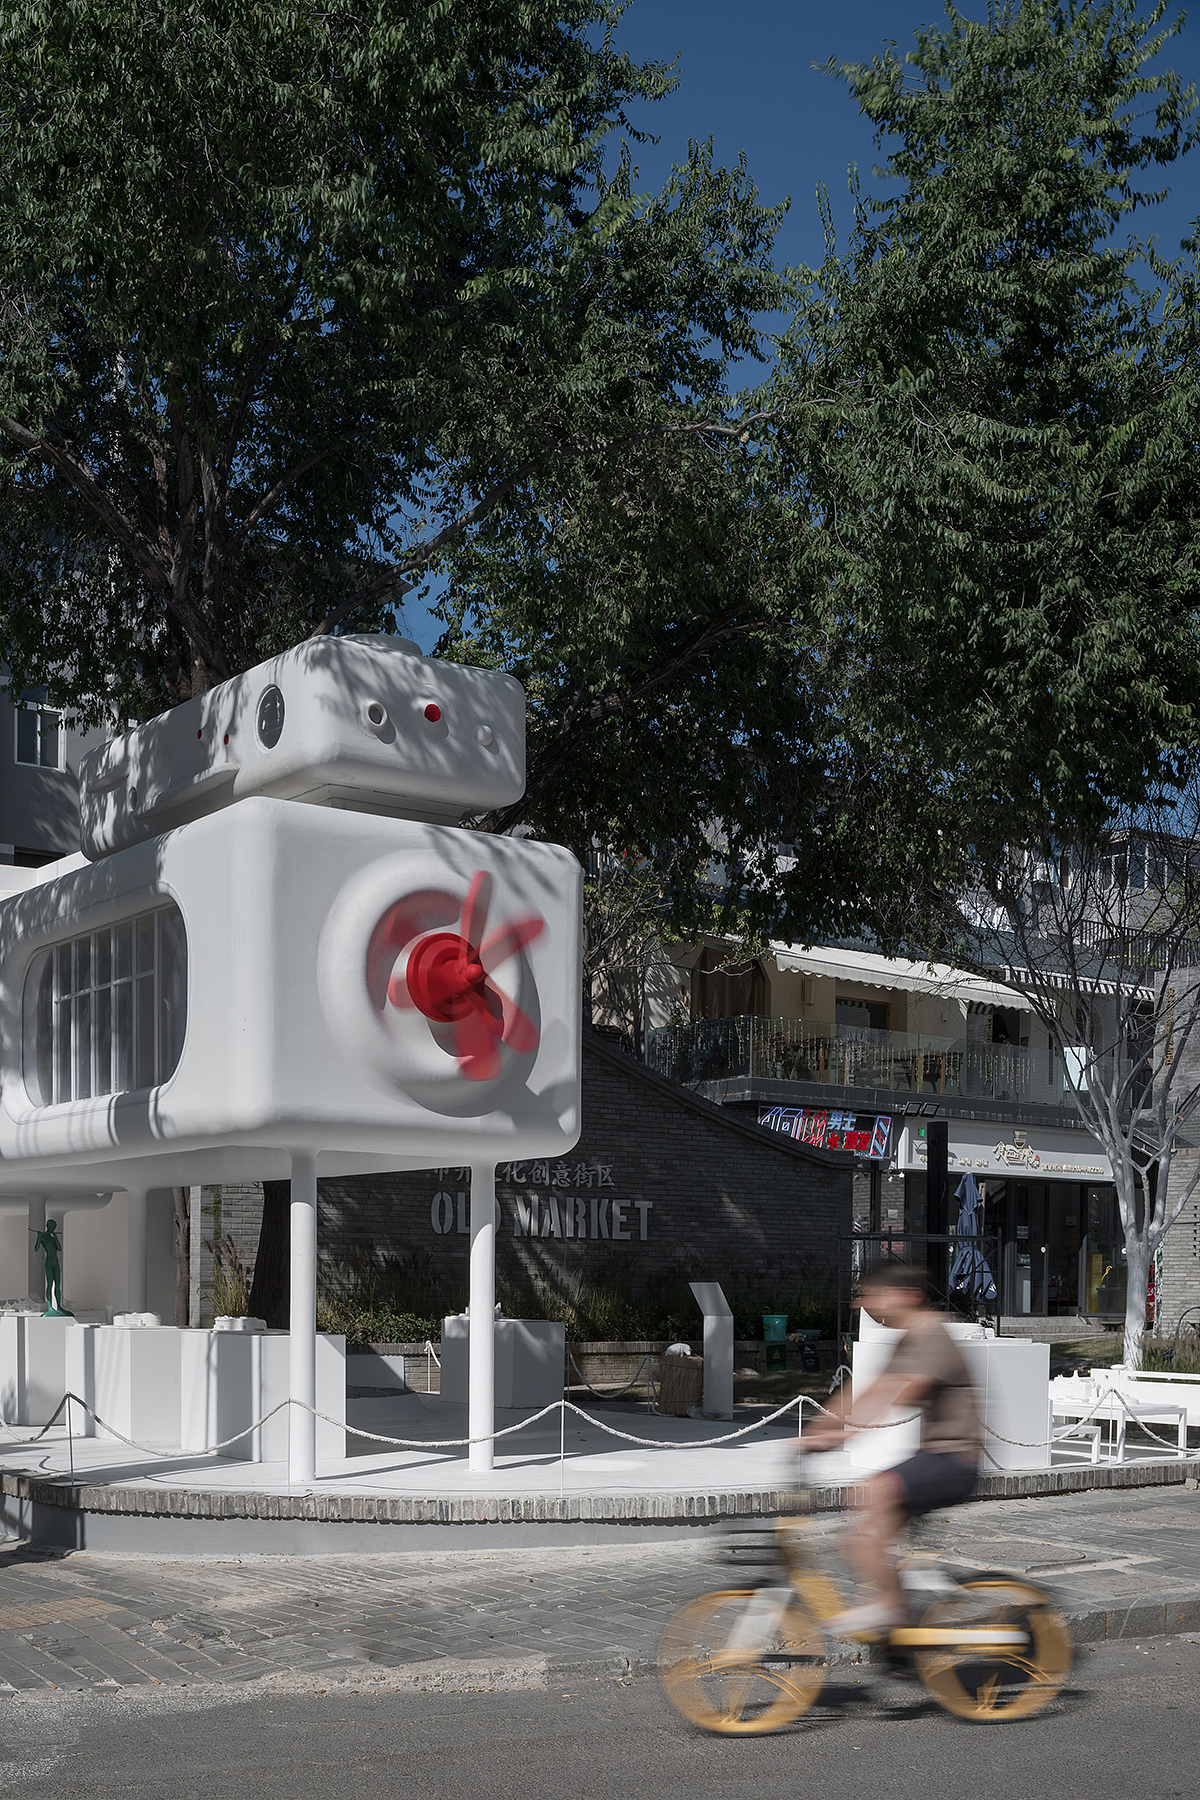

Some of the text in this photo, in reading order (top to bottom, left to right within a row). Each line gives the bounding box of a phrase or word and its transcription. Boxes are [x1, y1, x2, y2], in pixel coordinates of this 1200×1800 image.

[828, 1111, 857, 1131] 男士
[843, 1131, 872, 1150] 理发
[430, 1191, 653, 1241] OL MARKET
